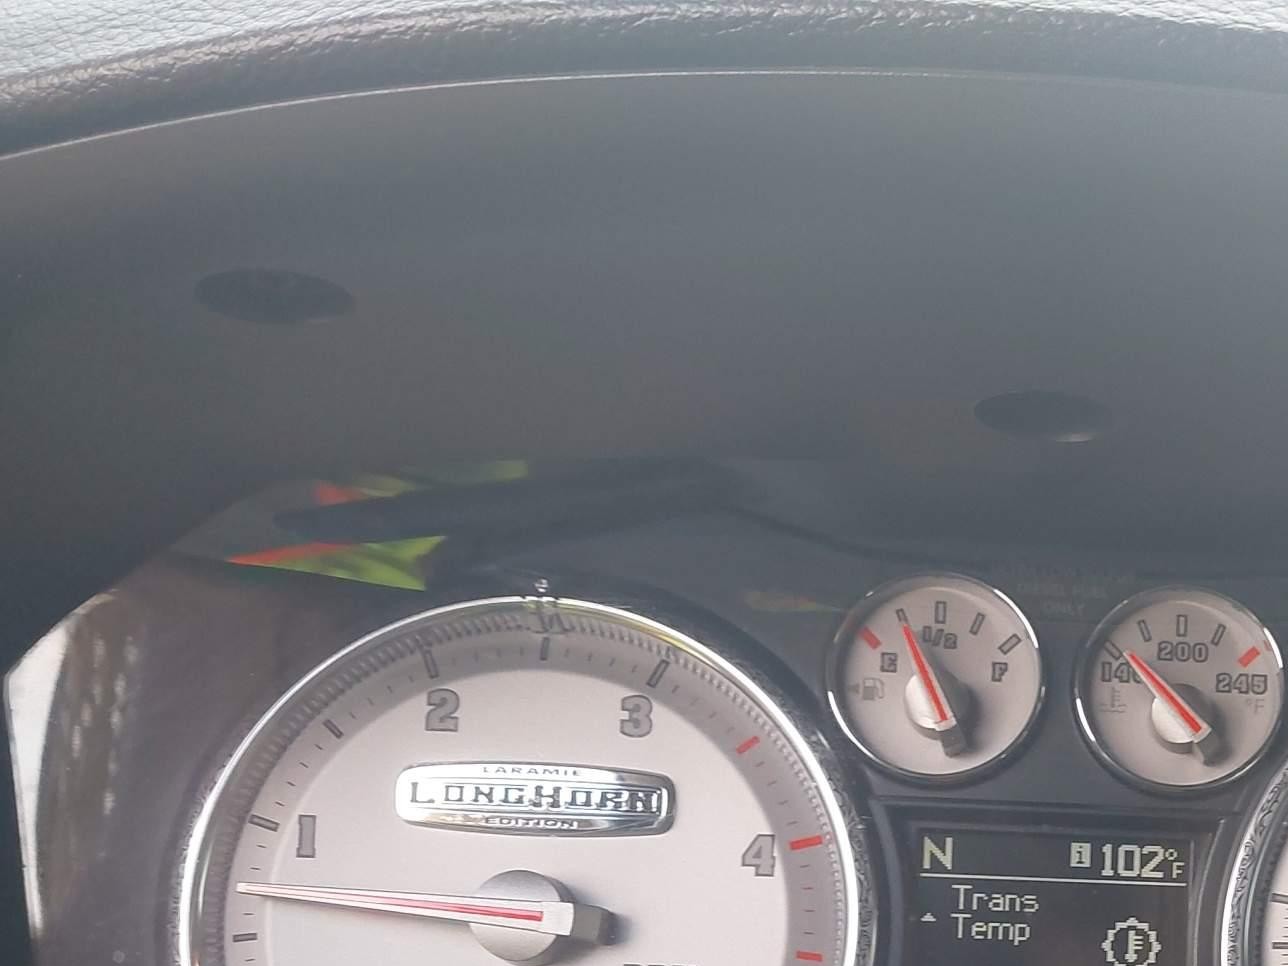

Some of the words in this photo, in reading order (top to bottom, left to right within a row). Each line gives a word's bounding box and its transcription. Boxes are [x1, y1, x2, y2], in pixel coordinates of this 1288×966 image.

[921, 626, 957, 650] 1/2
[1157, 641, 1209, 663] 200
[880, 652, 898, 673] E
[991, 663, 1008, 682] F
[1216, 672, 1268, 695] 245
[425, 689, 459, 732] 2
[620, 696, 654, 738] 3
[482, 766, 581, 777] LARAMIE
[296, 815, 317, 858] 1
[742, 834, 776, 876] 4
[921, 837, 953, 870] N
[951, 885, 1039, 914] Trans
[950, 912, 1031, 946] Temp
